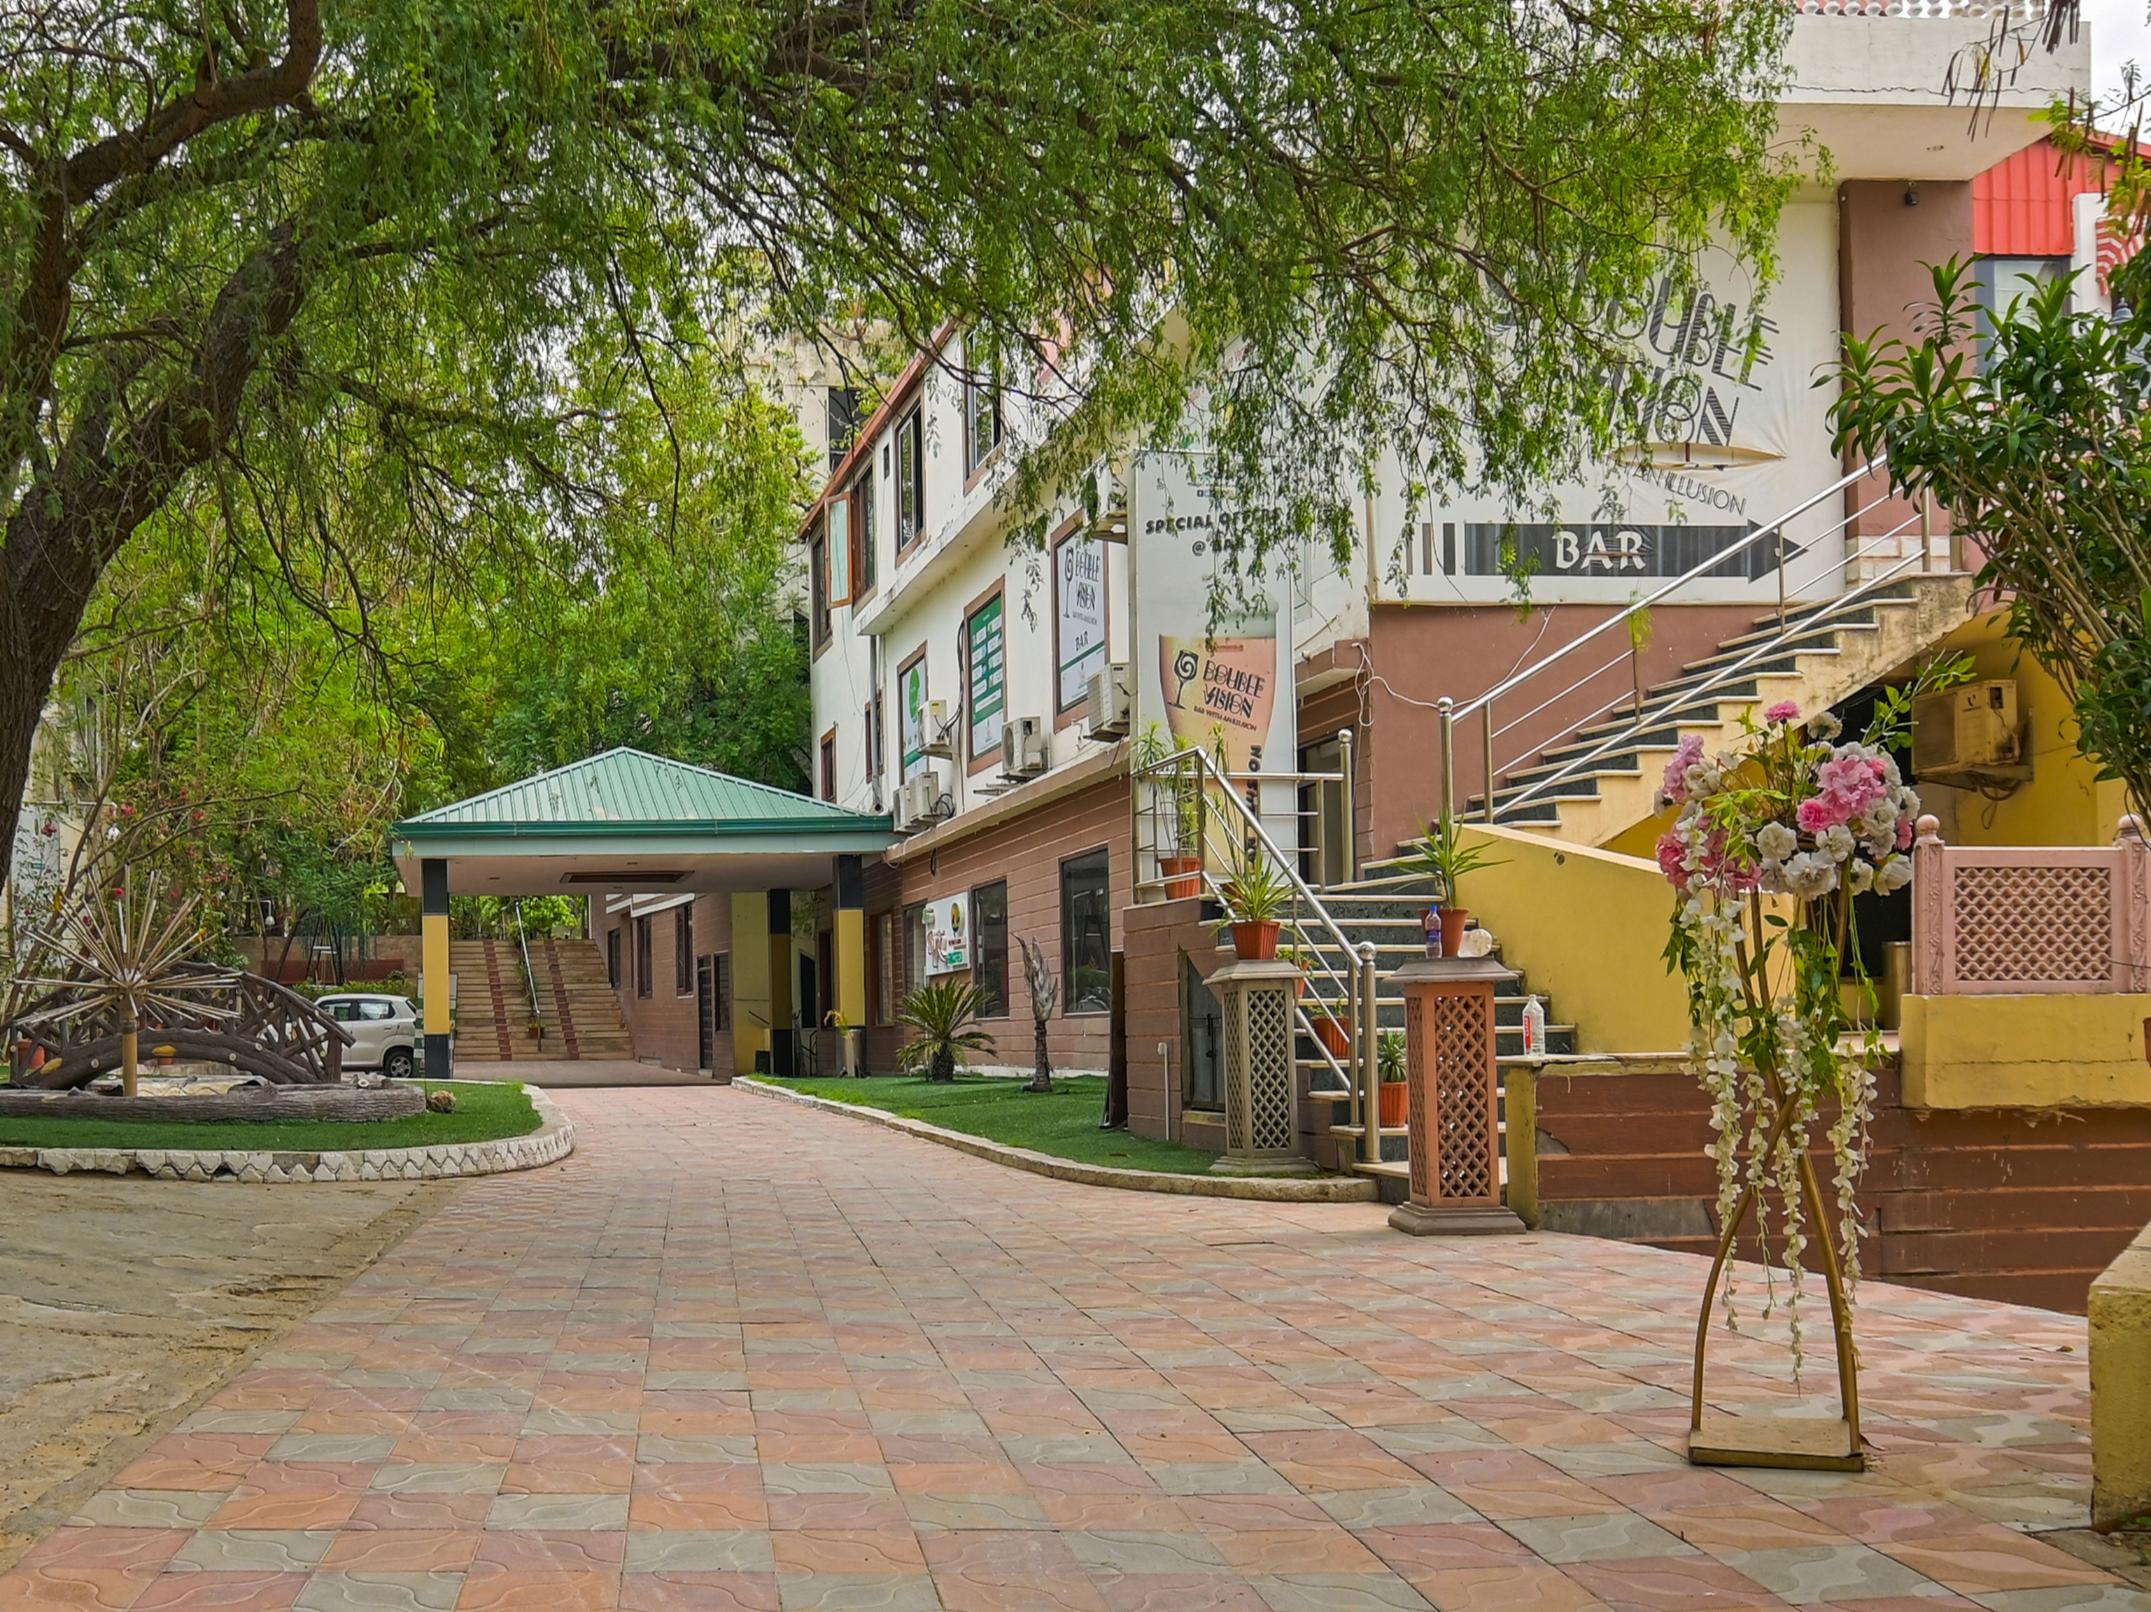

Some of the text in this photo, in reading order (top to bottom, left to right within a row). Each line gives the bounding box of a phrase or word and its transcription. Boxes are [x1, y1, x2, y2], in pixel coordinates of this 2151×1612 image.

[1568, 347, 1739, 446] IION
[1664, 470, 1746, 516] ILLUSION
[1192, 541, 1206, 557] @
[1552, 530, 1646, 570] BAR
[1075, 631, 1089, 652] BAR
[1203, 660, 1265, 698] DOUBLE
[1203, 683, 1254, 718] VISION
